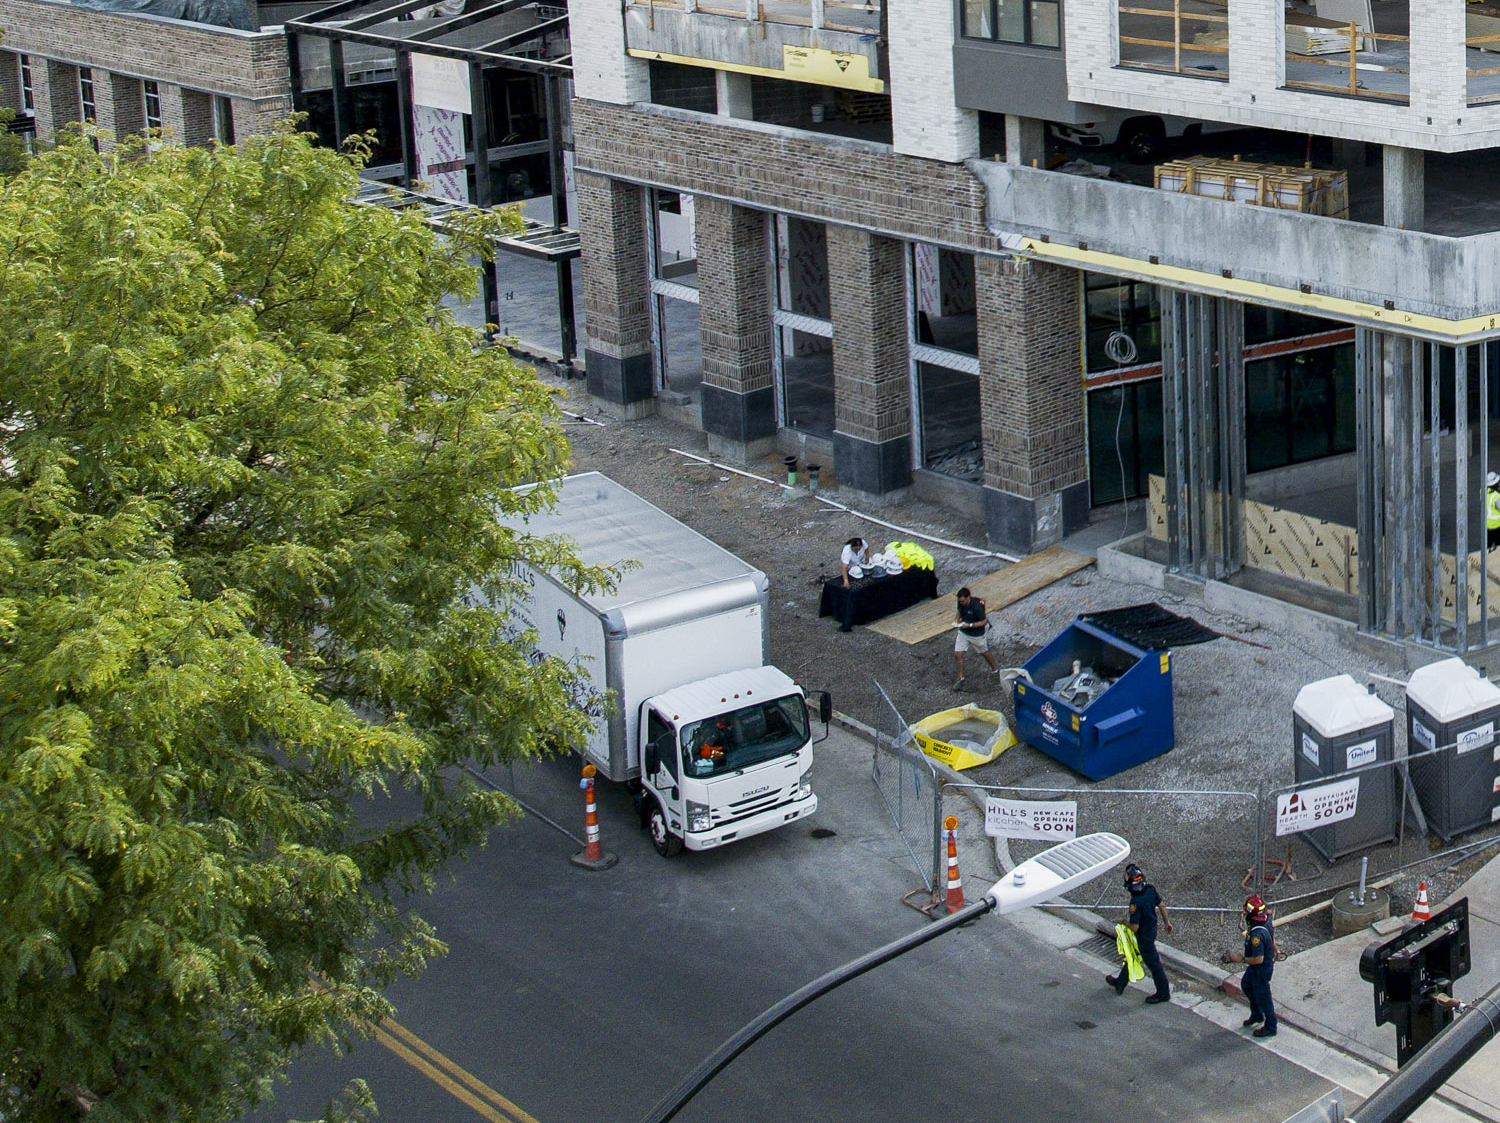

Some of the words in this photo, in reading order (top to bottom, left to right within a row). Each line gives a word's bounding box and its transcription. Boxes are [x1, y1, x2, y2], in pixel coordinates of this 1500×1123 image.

[1351, 746, 1375, 760] United
[742, 785, 770, 798] ISUZU
[1314, 787, 1357, 803] RESTAURANT
[1314, 794, 1356, 811] OPENING
[988, 805, 1027, 817] HILL'S
[1314, 801, 1355, 821] SOON
[987, 816, 1027, 826] kitchen
[1279, 813, 1308, 824] HEARTH
[1033, 822, 1074, 832] SOON
